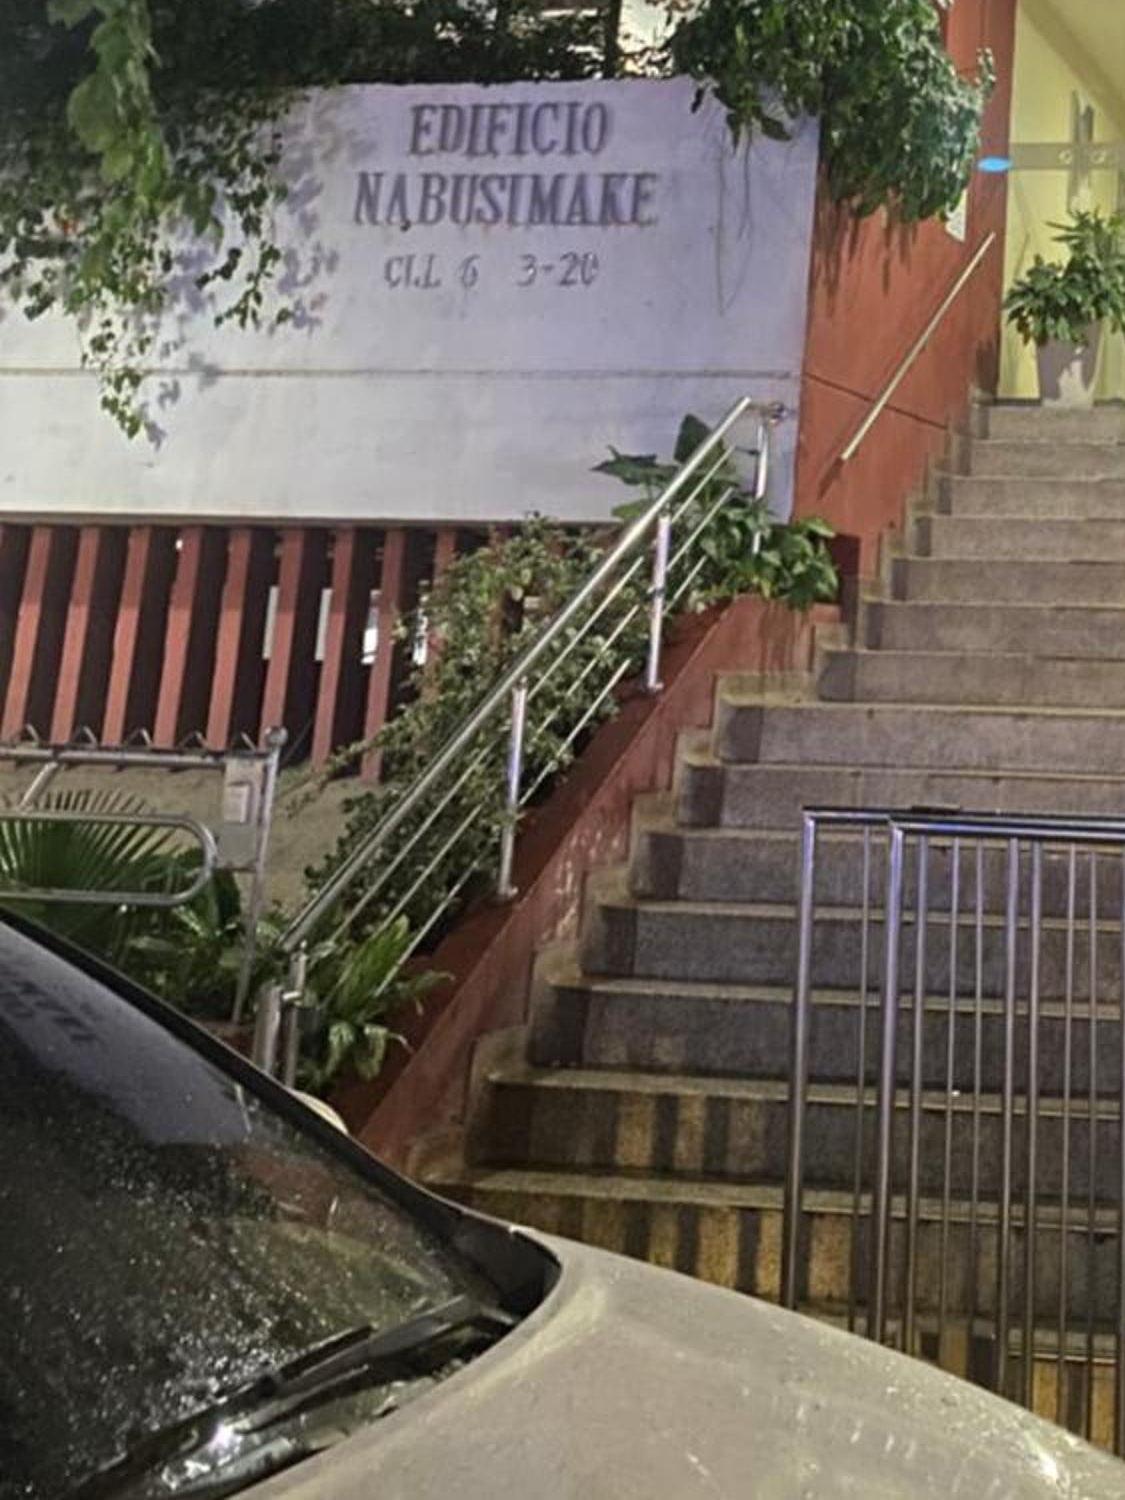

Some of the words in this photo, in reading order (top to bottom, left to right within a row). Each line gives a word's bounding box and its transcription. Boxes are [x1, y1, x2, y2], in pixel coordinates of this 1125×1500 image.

[408, 100, 611, 159] EDIFICIO
[353, 171, 661, 228] NABUSIMAKE
[384, 254, 442, 290] CLL
[459, 254, 480, 289] 6
[517, 250, 600, 288] 3-20
